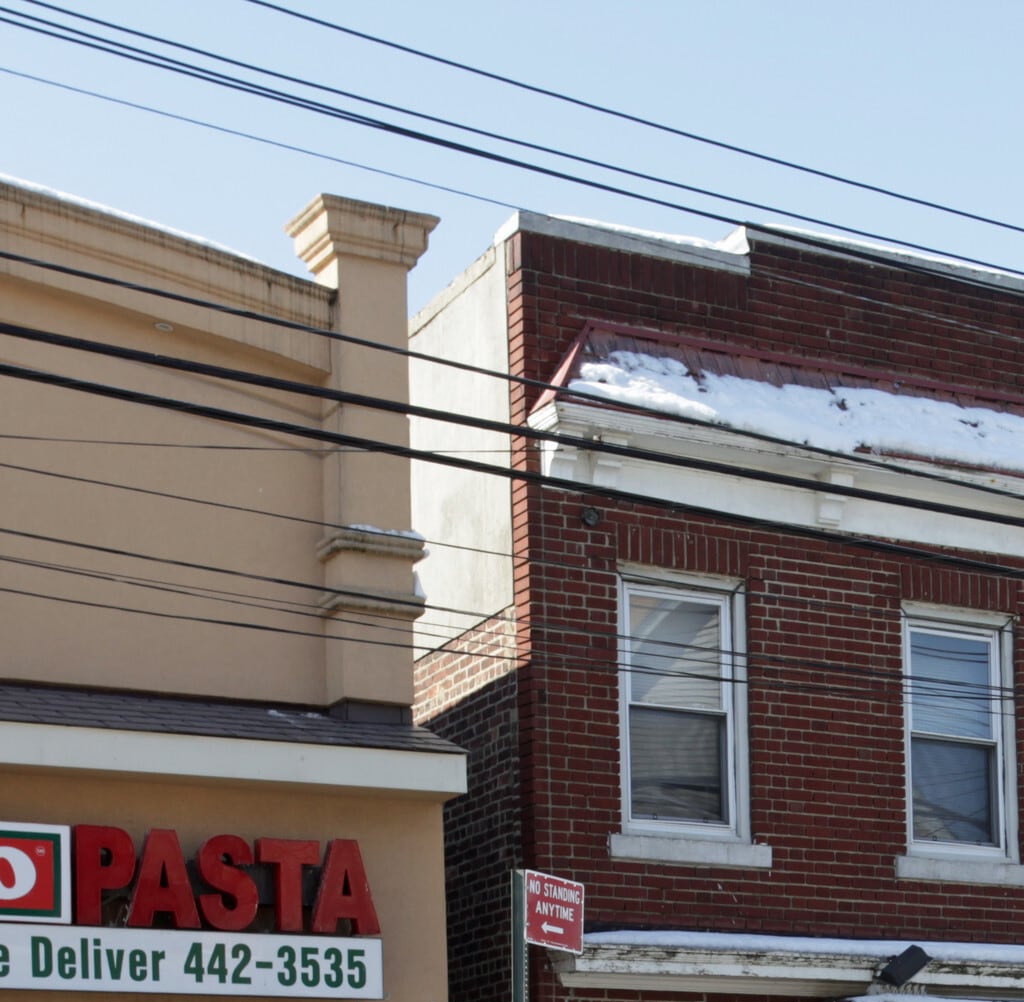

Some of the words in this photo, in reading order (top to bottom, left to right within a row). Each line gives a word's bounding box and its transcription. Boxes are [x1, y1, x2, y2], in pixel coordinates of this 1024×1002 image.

[75, 824, 382, 935] PASTA
[529, 880, 541, 895] NO
[544, 883, 580, 905] STANDING
[536, 901, 574, 922] ANYTIME
[31, 935, 166, 982] Deliver
[184, 942, 368, 989] 442-3535
